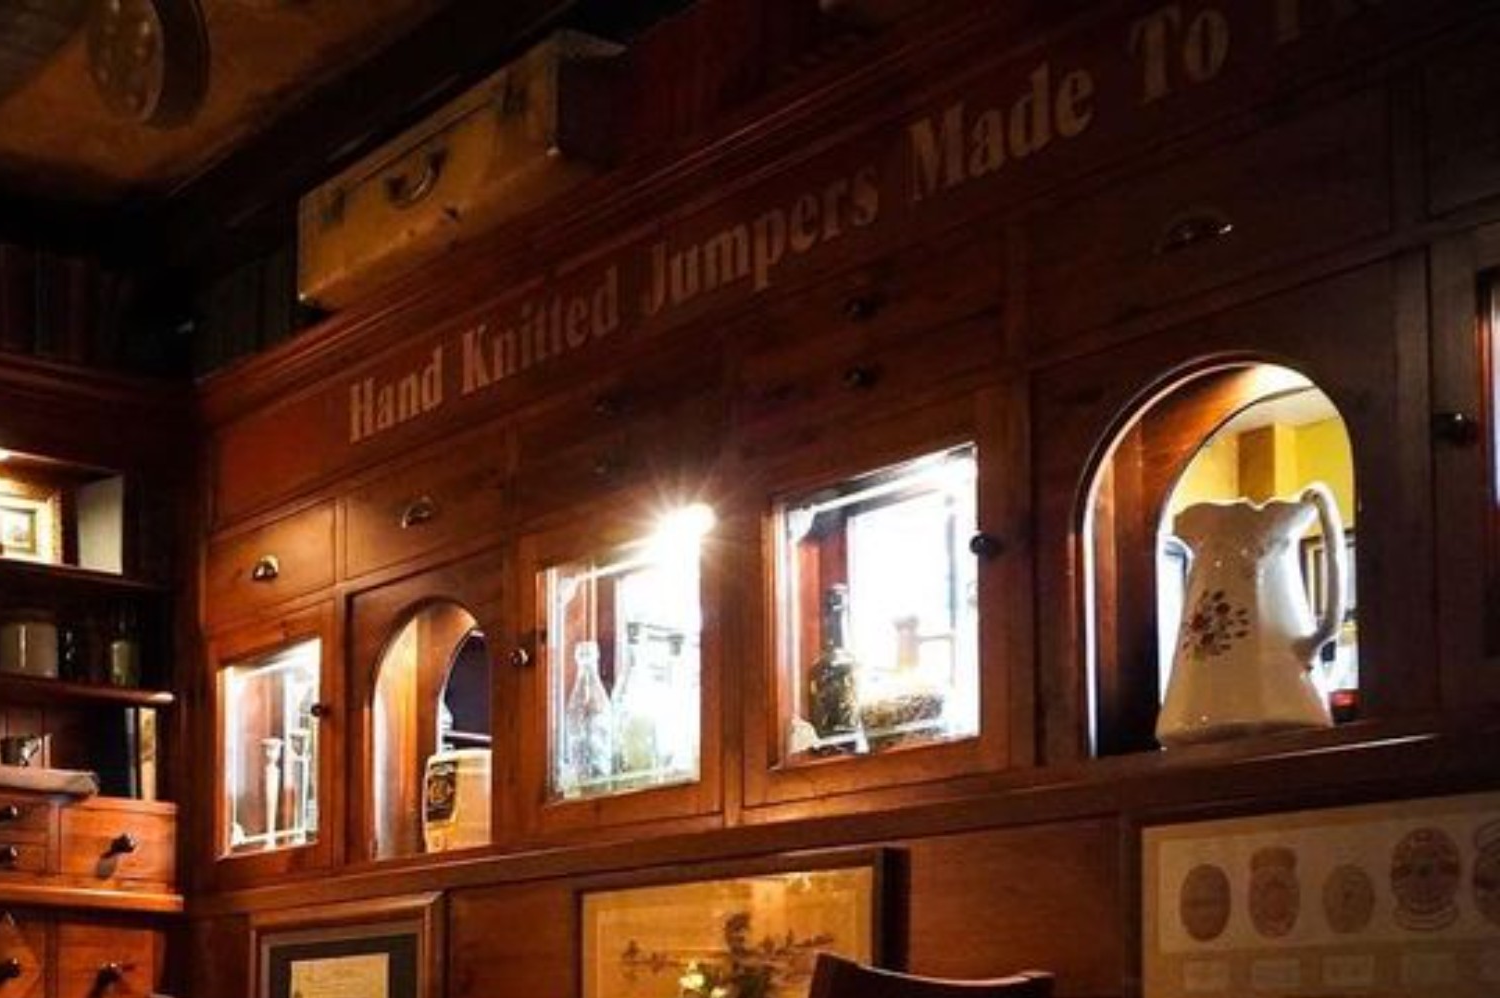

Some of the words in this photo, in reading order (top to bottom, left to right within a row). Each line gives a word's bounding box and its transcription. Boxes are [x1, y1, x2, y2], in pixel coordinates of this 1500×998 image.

[348, 346, 443, 445] Hand
[461, 263, 621, 396] Knitted
[643, 163, 882, 316] Jumpers
[902, 66, 1096, 203] Made
[1130, 4, 1231, 102] To
